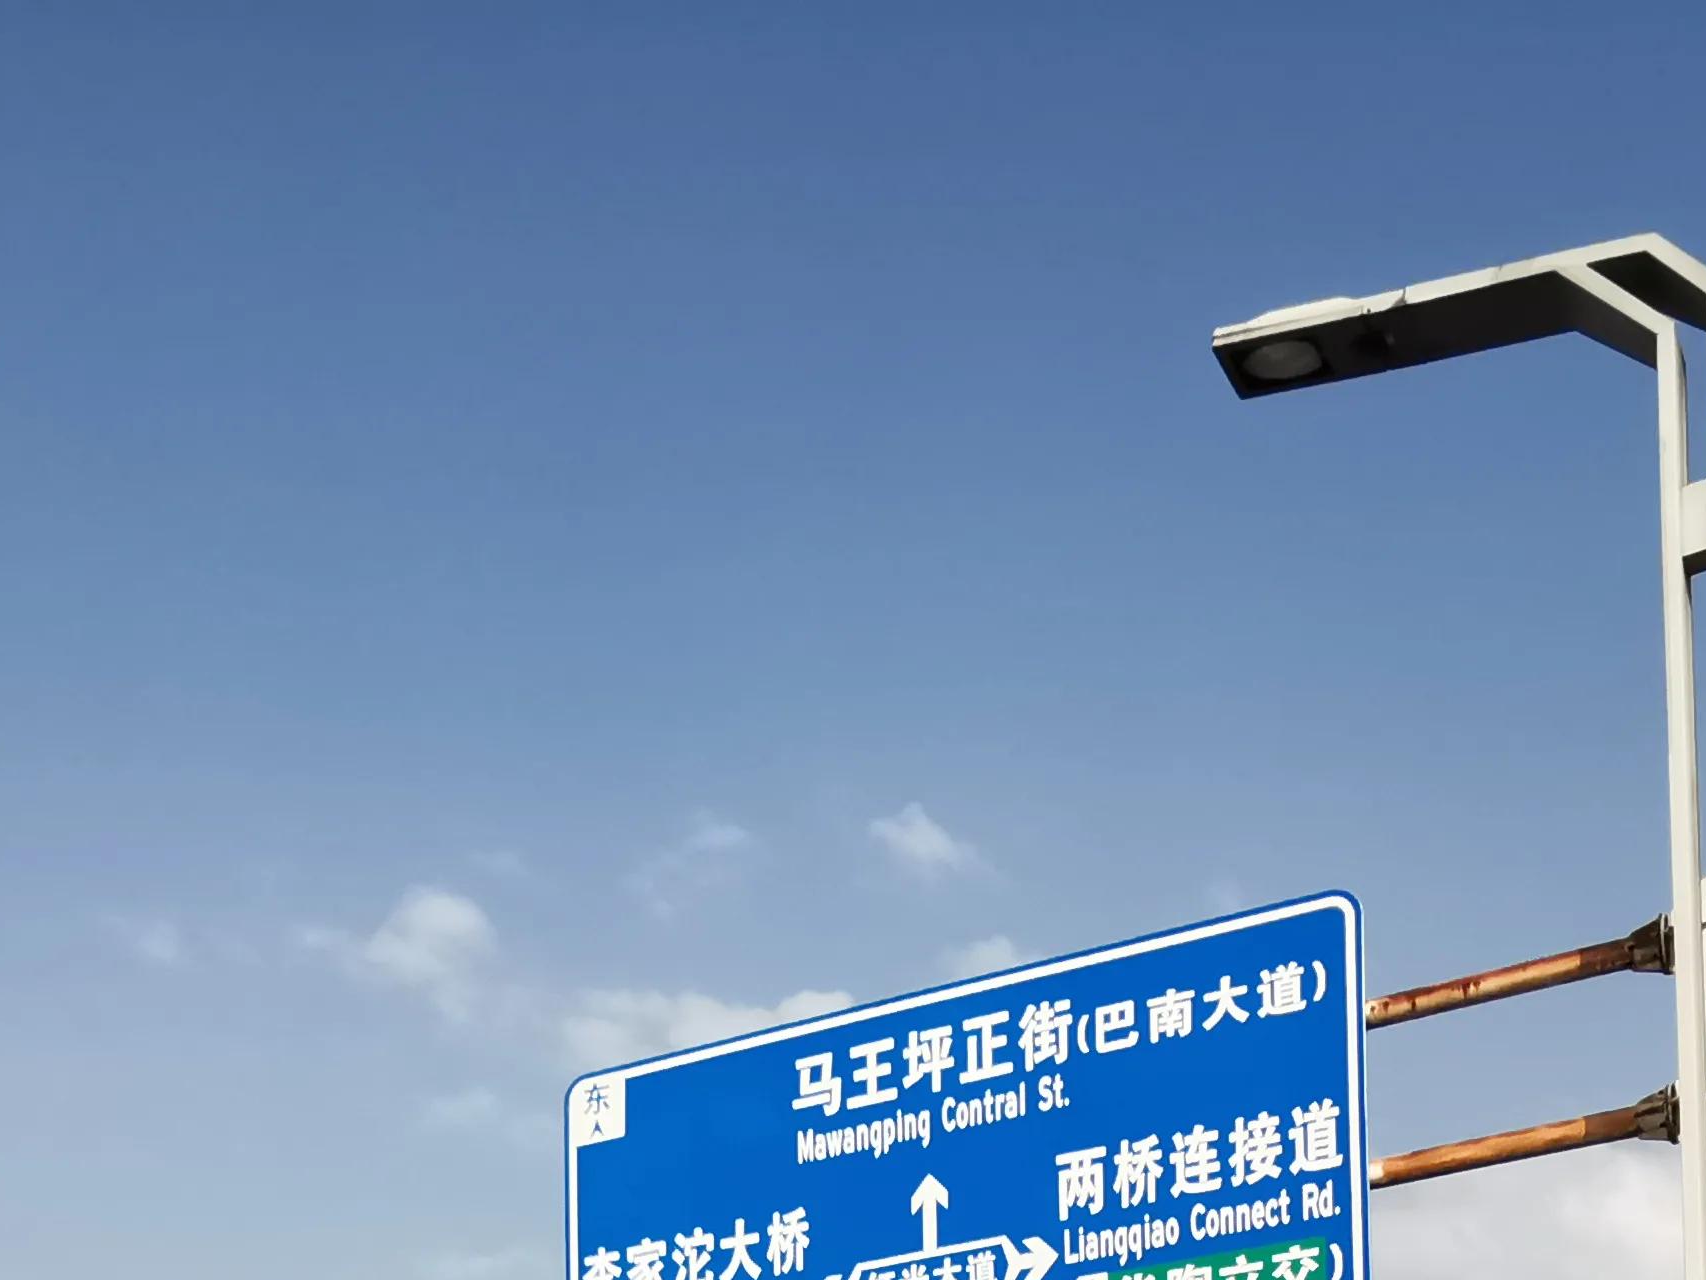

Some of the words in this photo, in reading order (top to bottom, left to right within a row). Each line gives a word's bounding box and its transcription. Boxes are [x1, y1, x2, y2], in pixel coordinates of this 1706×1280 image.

[796, 1105, 932, 1164] Mawangping
[941, 1081, 1026, 1132] Contral
[1037, 1073, 1071, 1112] St.
[1055, 1098, 1344, 1222] 两桥连接道
[1063, 1213, 1180, 1267] Liangqiao
[1189, 1188, 1291, 1242] Connect
[1301, 1179, 1342, 1221] Rd.
